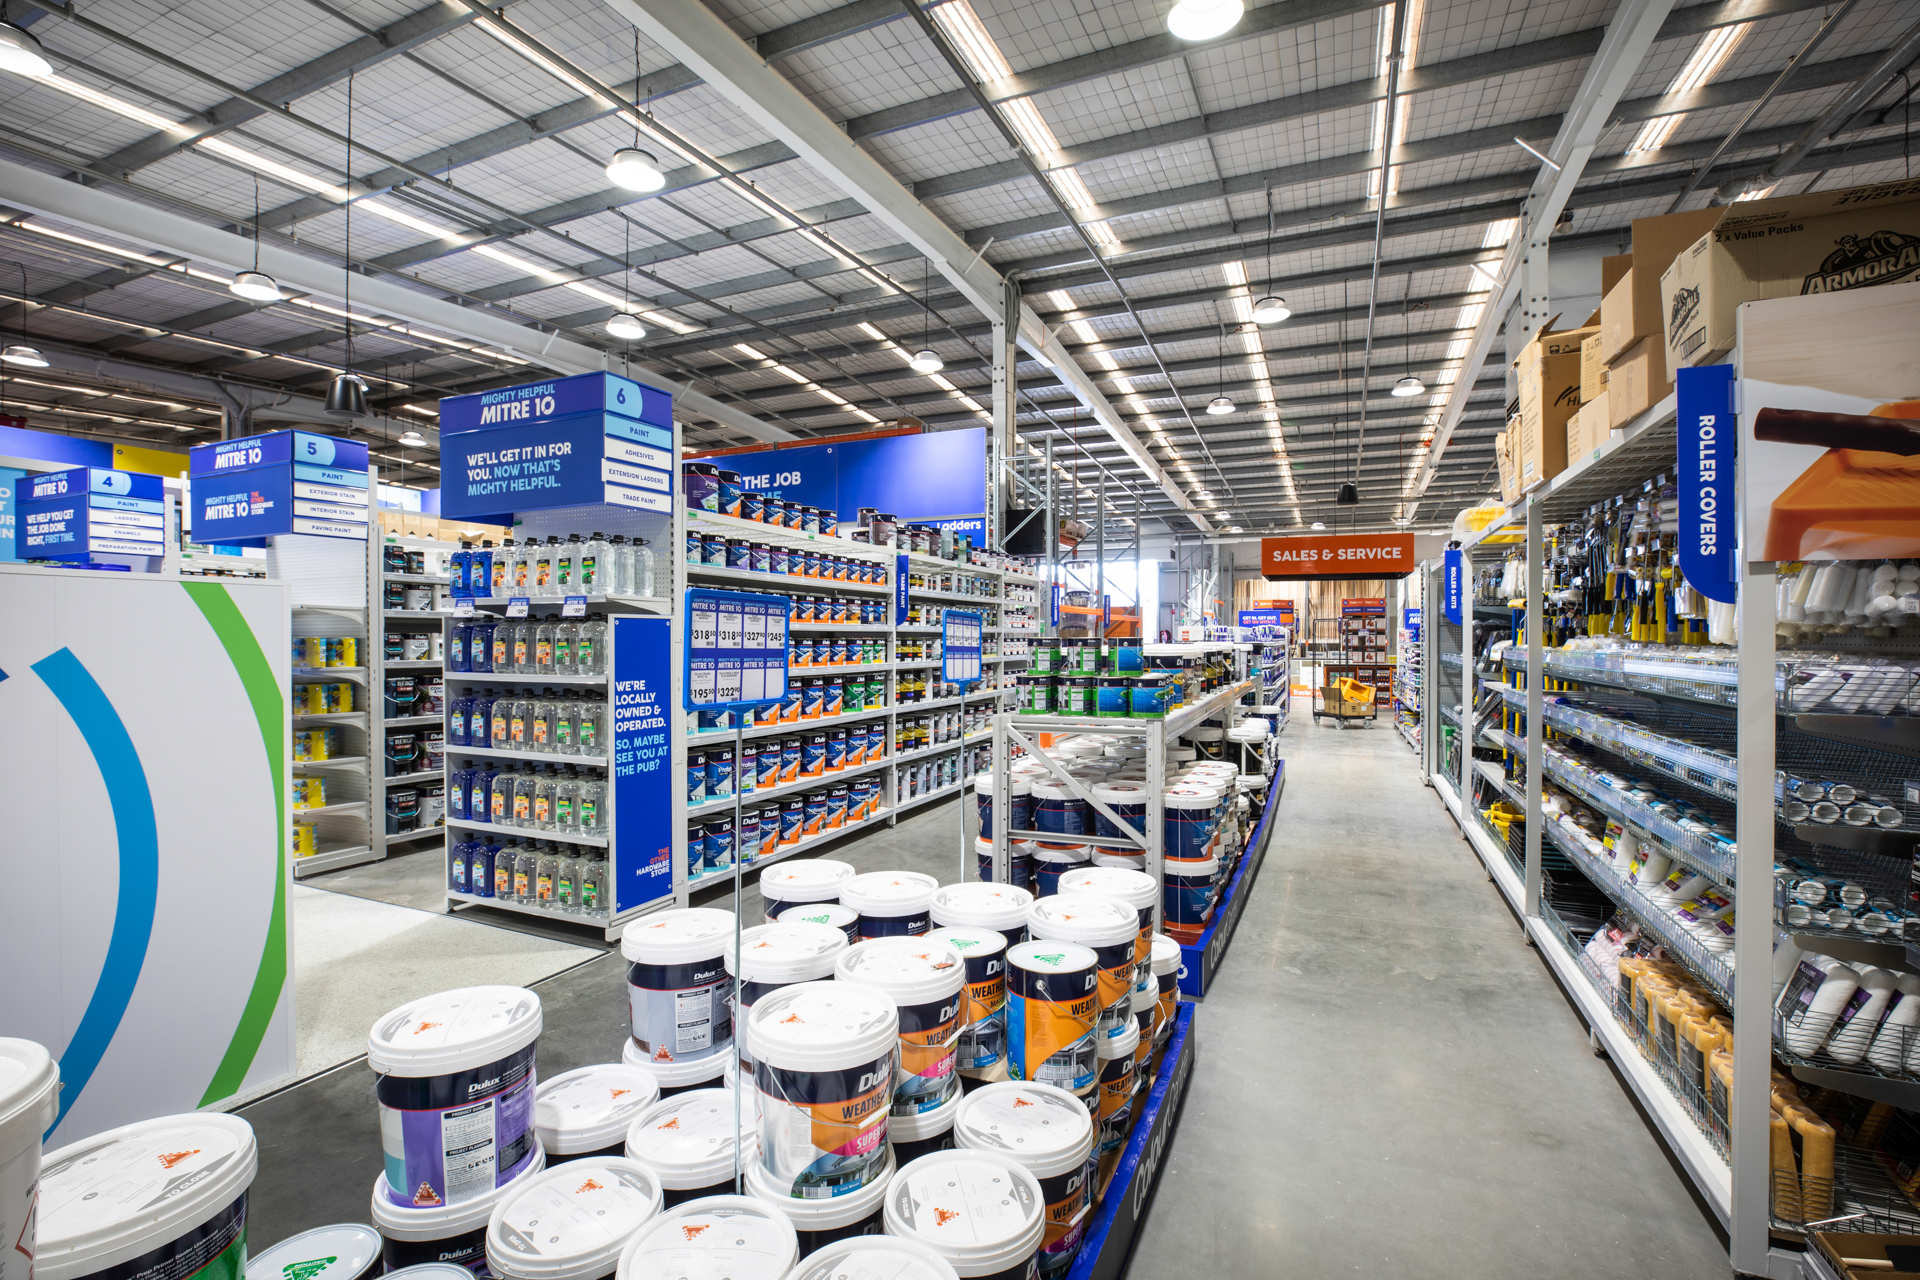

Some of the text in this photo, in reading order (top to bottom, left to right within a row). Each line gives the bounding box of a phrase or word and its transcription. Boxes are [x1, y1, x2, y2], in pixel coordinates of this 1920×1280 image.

[1715, 223, 1804, 243] 2 x Value Packs
[480, 383, 556, 406] MIGHTY HELPFUL
[616, 388, 626, 405] 6
[480, 396, 556, 425] MITRE 10
[629, 426, 650, 438] PAINT
[215, 439, 262, 454] MIGHTY HELPFUL
[307, 441, 317, 455] 5
[214, 448, 262, 469] MITRE 10
[467, 442, 572, 467] WE'LL GET IT IN FOR
[625, 449, 655, 461] ADHESIVES
[321, 472, 344, 481] PAINT
[467, 458, 561, 481] YOU. NOW THAT'S
[608, 468, 664, 485] EXTENSION LADDERS
[102, 476, 114, 488] 4
[467, 475, 561, 497] MIGHTY HELPFUL.
[742, 471, 802, 490] THE JOB
[1699, 414, 1717, 556] ROLLER COVERS
[33, 481, 68, 498] MITRE 10
[309, 488, 338, 497] EXTERIOR
[117, 500, 139, 508] PAINT
[205, 492, 249, 506] MIGHTY HELPFUL
[250, 496, 265, 504] OTHER
[250, 500, 274, 510] HARDWARE
[622, 493, 657, 505] TRADE PAINT
[26, 509, 75, 524] WE HELP YOU GET
[205, 502, 249, 521] MITRE 10
[250, 508, 265, 516] STORE
[309, 506, 338, 514] INTERIOR
[26, 521, 66, 535] THE JOB DONE
[114, 529, 141, 537] ENAMELS
[936, 520, 982, 532] Ladders
[27, 532, 75, 546] RIGHT, FIRST TIME.
[98, 543, 138, 551] PREPARATION
[1273, 547, 1402, 562] SALES & SERVICE
[692, 602, 709, 610] MITRE
[709, 603, 716, 611] 10
[719, 604, 735, 612] MITRE
[708, 661, 715, 669] 10
[718, 661, 734, 669] MITRE
[615, 680, 646, 692] WE'RE
[615, 692, 657, 706] LOCALLY
[615, 705, 662, 719] OWNED &
[615, 718, 667, 733] OPERATED.
[615, 733, 666, 751] SO, MAYBE
[615, 745, 669, 764] SEE YOU AT
[615, 759, 661, 778] THE PUB?
[658, 847, 670, 856] THE
[650, 853, 670, 865] OTHER
[636, 860, 670, 877] HARDWARE
[650, 866, 670, 878] STORE
[693, 969, 717, 981] Dulux
[1800, 963, 1817, 978] Accent
[468, 1076, 501, 1093] Dulux
[451, 1108, 472, 1118] PRODUCT
[449, 1147, 468, 1155] PROJECT
[165, 1169, 212, 1200] TO CLOSE
[136, 1229, 219, 1278] Prep Primer Sealer Undercoat
[439, 1246, 474, 1263] Dulux
